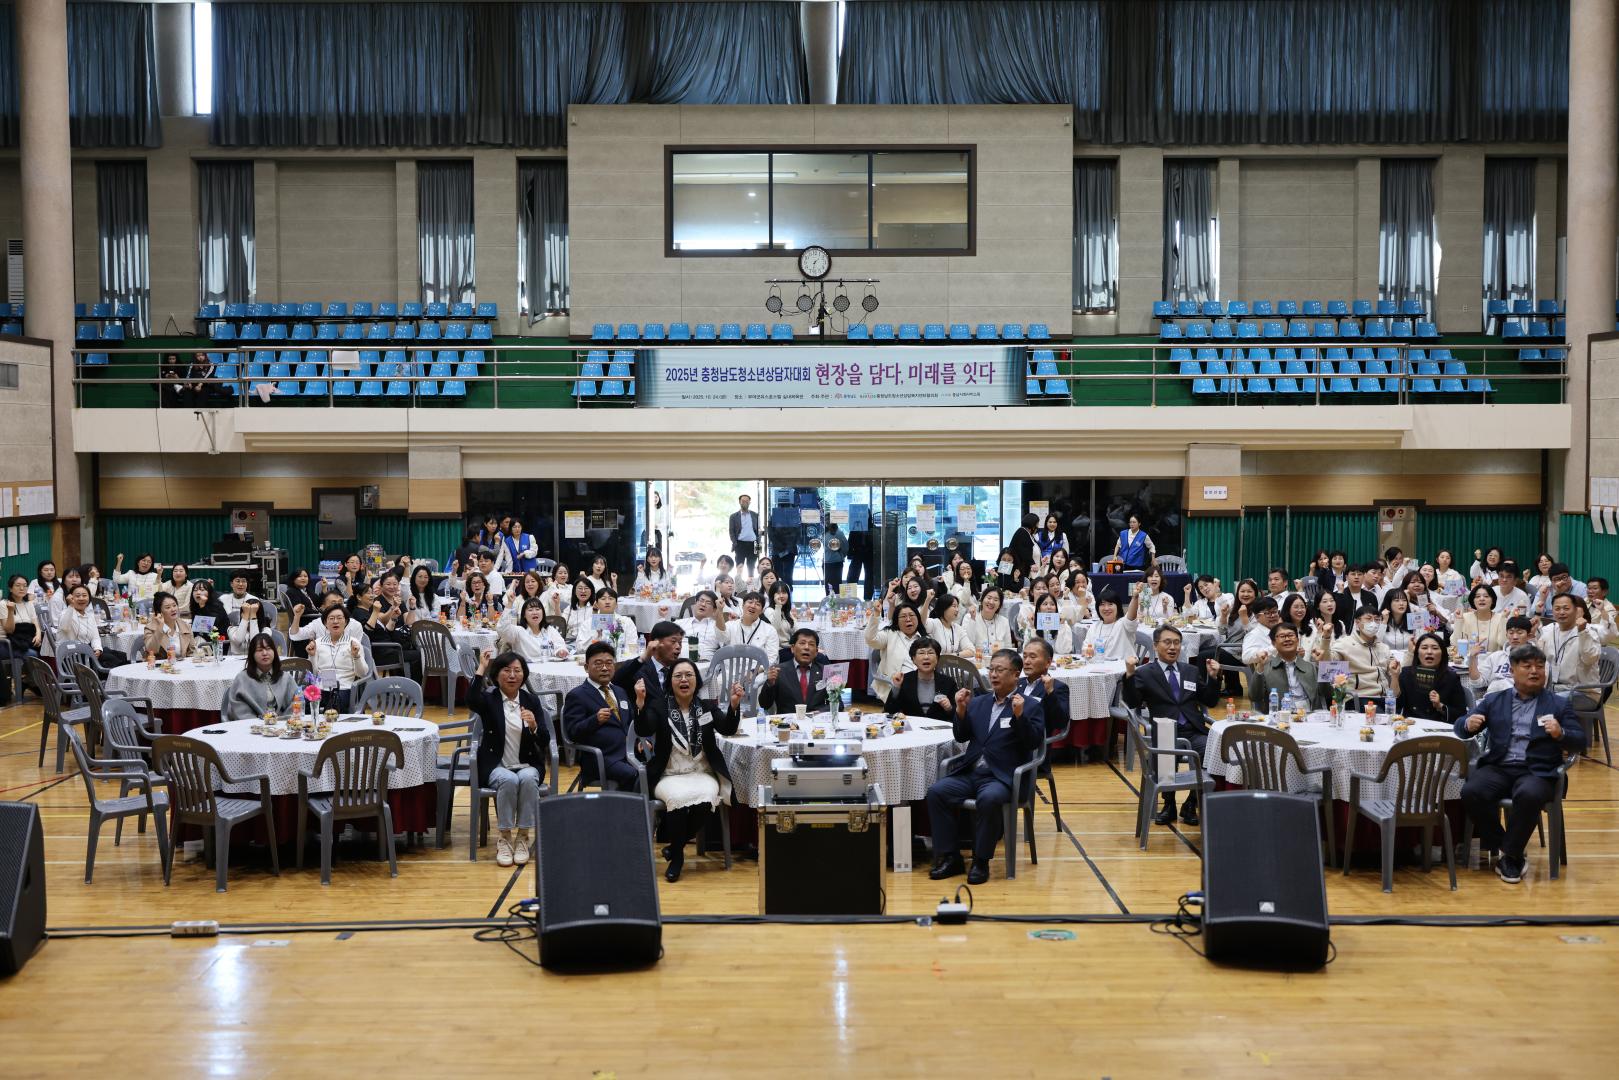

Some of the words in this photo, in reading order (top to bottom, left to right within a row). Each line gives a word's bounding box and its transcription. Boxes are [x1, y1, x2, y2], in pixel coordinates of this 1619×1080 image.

[665, 367, 698, 382] 2025년
[701, 366, 811, 382] 충청남도청소년상담자대회
[814, 362, 863, 386] 현장을
[869, 362, 904, 386] 담다,
[908, 362, 957, 386] 미래를
[963, 361, 996, 386] 잇다
